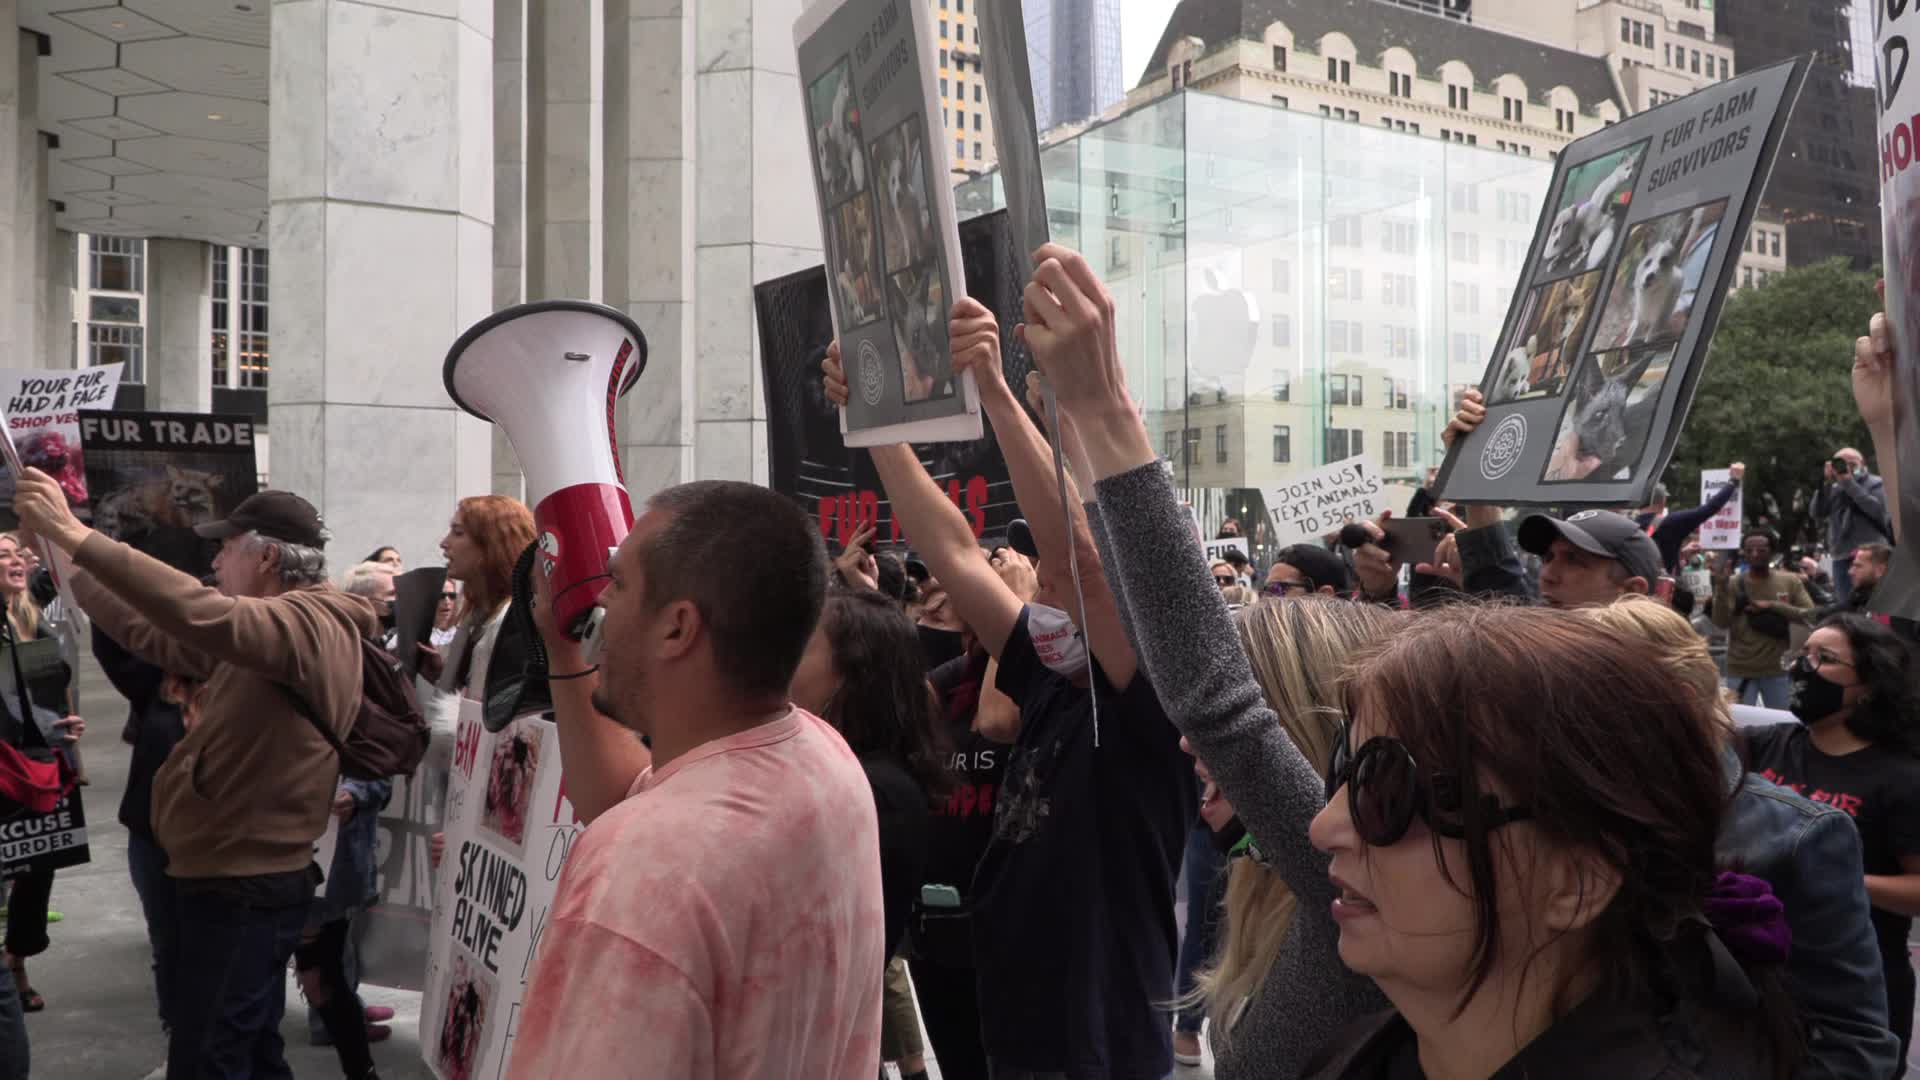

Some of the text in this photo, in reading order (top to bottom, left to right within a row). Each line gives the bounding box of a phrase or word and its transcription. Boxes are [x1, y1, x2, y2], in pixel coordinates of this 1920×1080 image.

[1661, 86, 1758, 155] FUR FARM
[1647, 125, 1751, 193] SURVIVORS
[20, 370, 105, 396] YOUR FUR
[8, 384, 110, 414] HAD A FACE
[9, 415, 54, 430] SHOP
[82, 418, 253, 446] FUR TRADE
[1277, 477, 1323, 504] JOIN
[818, 489, 878, 548] FUR
[1271, 500, 1310, 524] TEXT
[1295, 499, 1375, 534] TO 55678
[974, 750, 995, 770] IS
[455, 840, 528, 932] SKINNED
[451, 897, 503, 976] ALIVE
